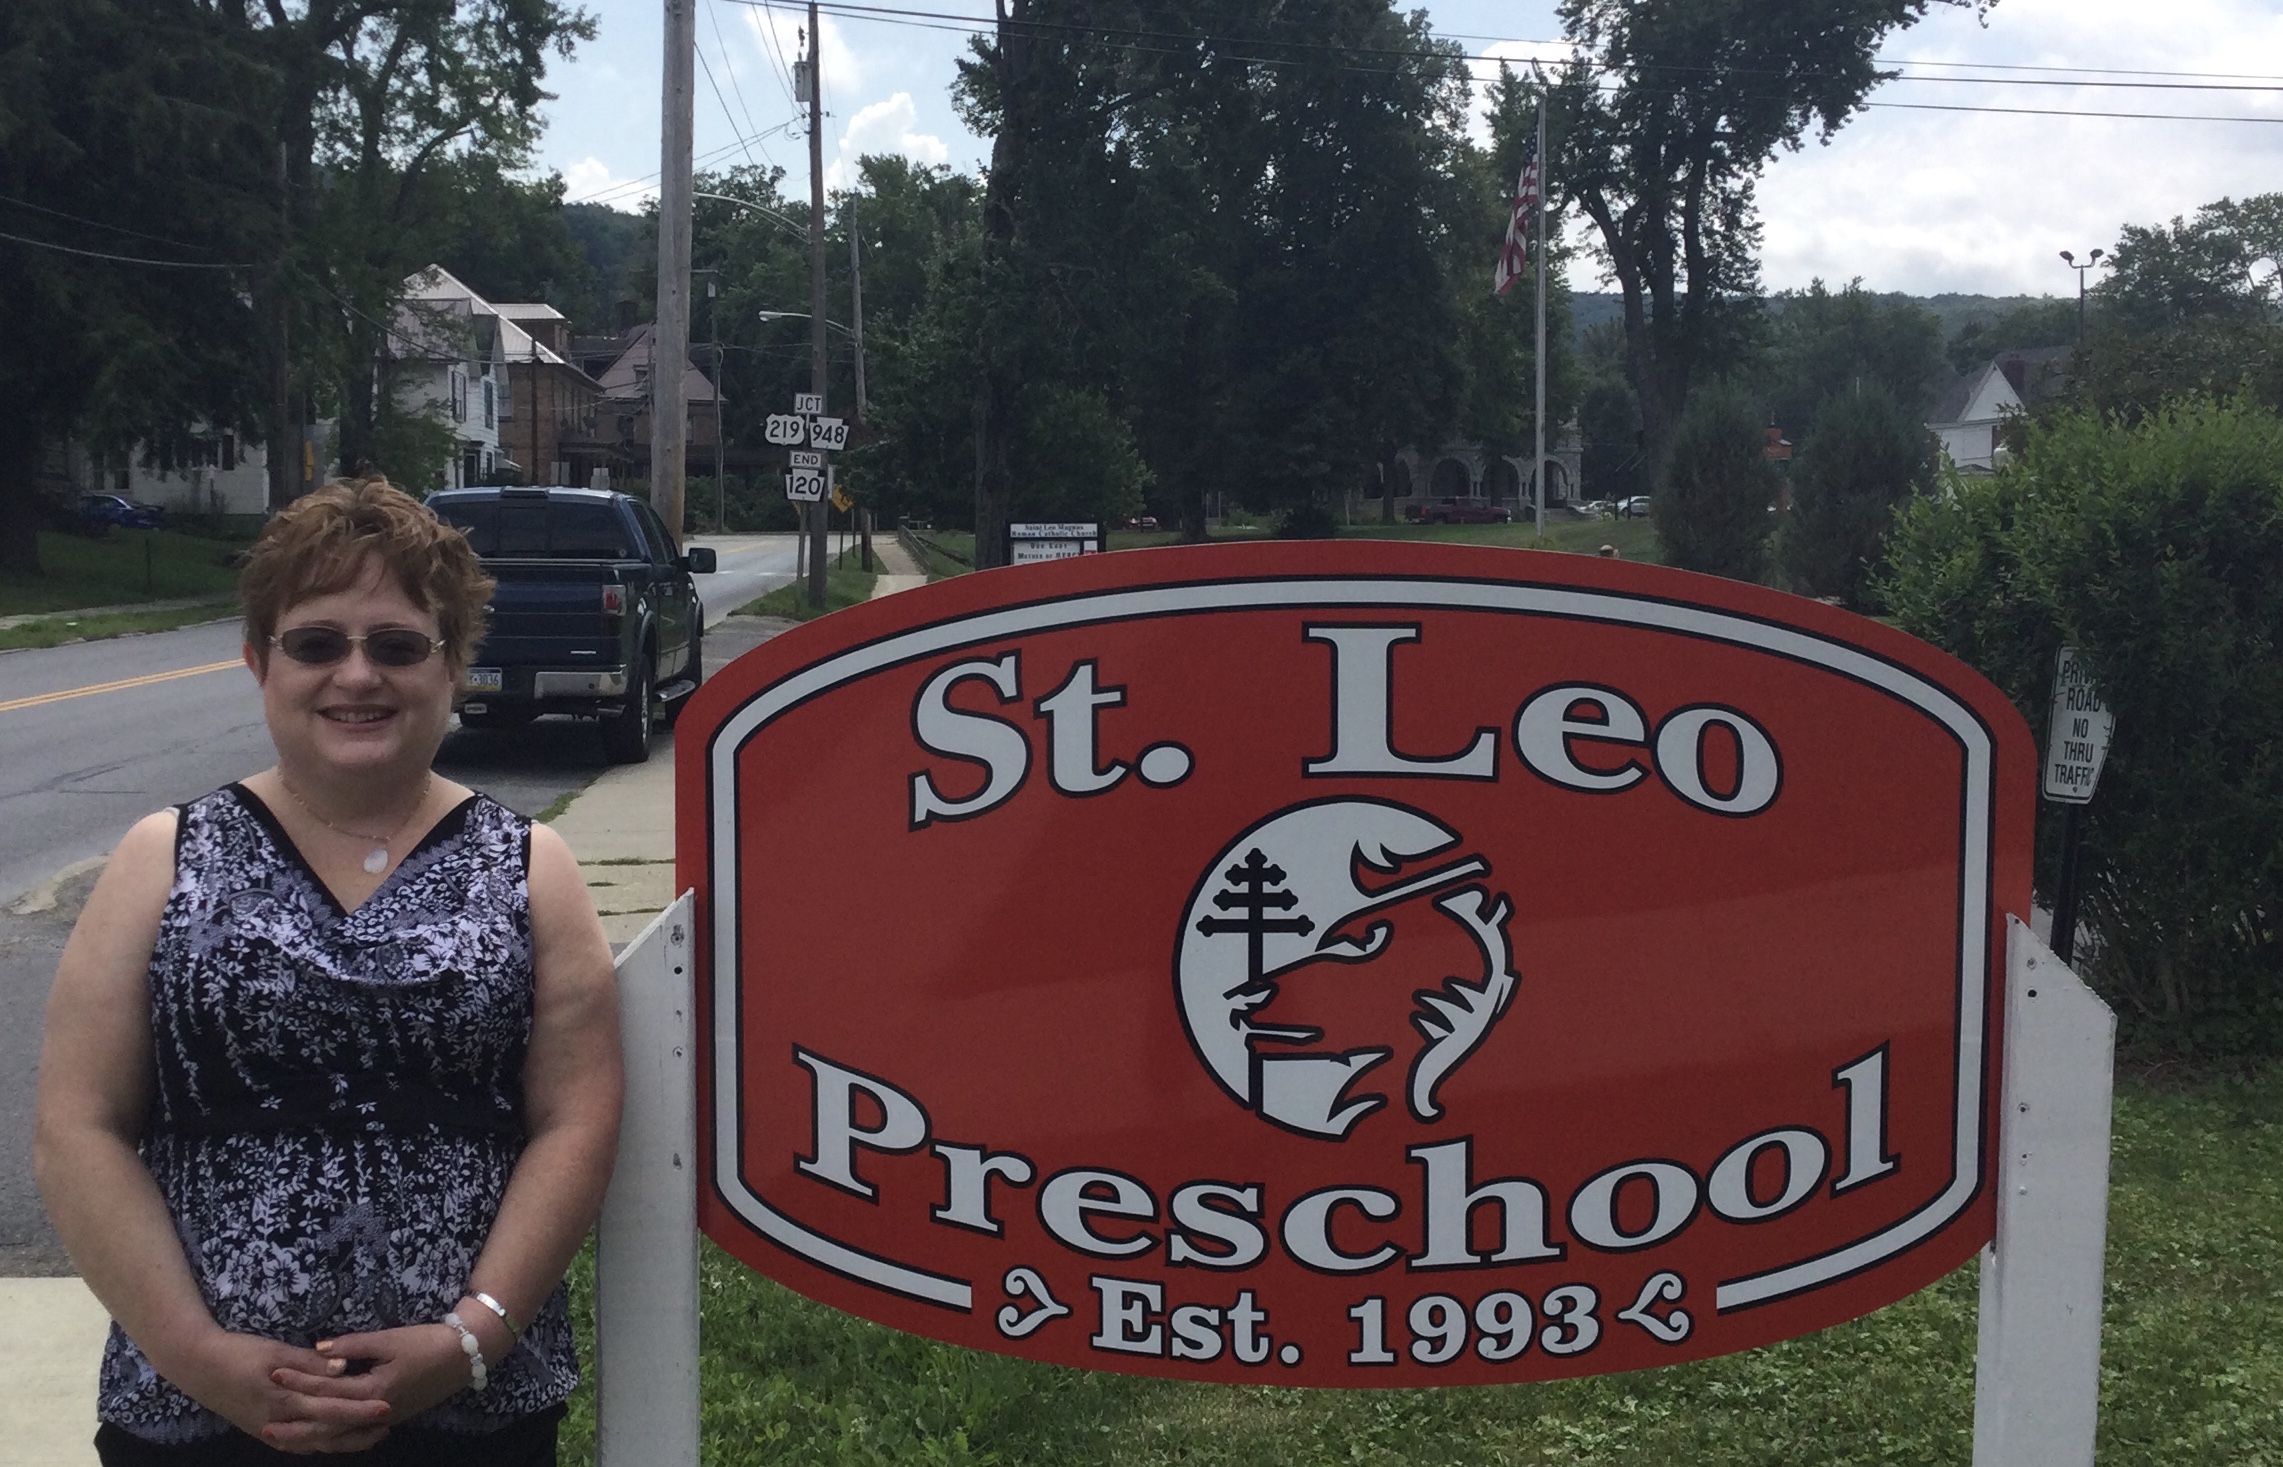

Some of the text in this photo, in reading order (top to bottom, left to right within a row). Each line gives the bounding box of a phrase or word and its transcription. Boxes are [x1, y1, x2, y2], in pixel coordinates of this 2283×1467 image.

[796, 396, 822, 412] JCT
[770, 420, 800, 438] 219
[812, 424, 845, 444] 948
[793, 454, 819, 465] END
[788, 475, 820, 495] 120
[908, 620, 1785, 832] St. Leo
[2072, 717, 2089, 739] NO
[2063, 740, 2095, 764] THRU
[792, 1039, 1901, 1274] Preschool
[1090, 1274, 1603, 1368] Est. 1993
